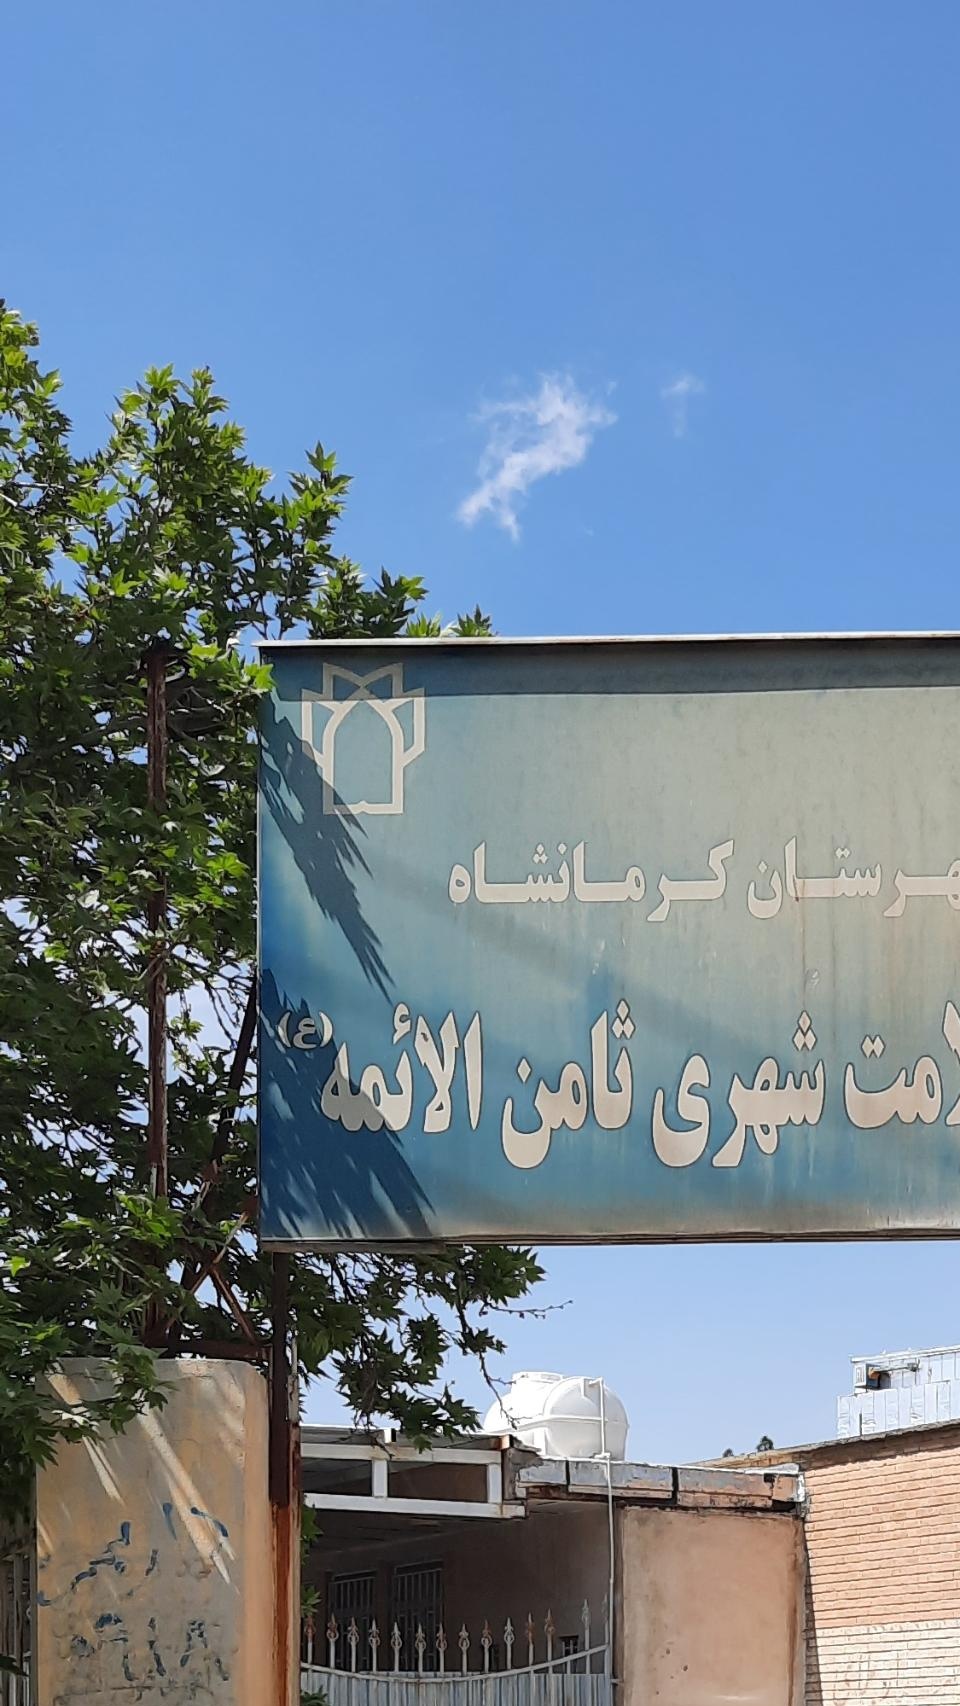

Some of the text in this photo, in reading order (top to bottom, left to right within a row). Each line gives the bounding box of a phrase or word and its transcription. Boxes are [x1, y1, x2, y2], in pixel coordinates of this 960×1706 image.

[447, 838, 735, 923] کرمانشاه
[276, 1010, 334, 1049] (ع)
[501, 998, 636, 1170] ثامن
[651, 1009, 826, 1169] شهری
